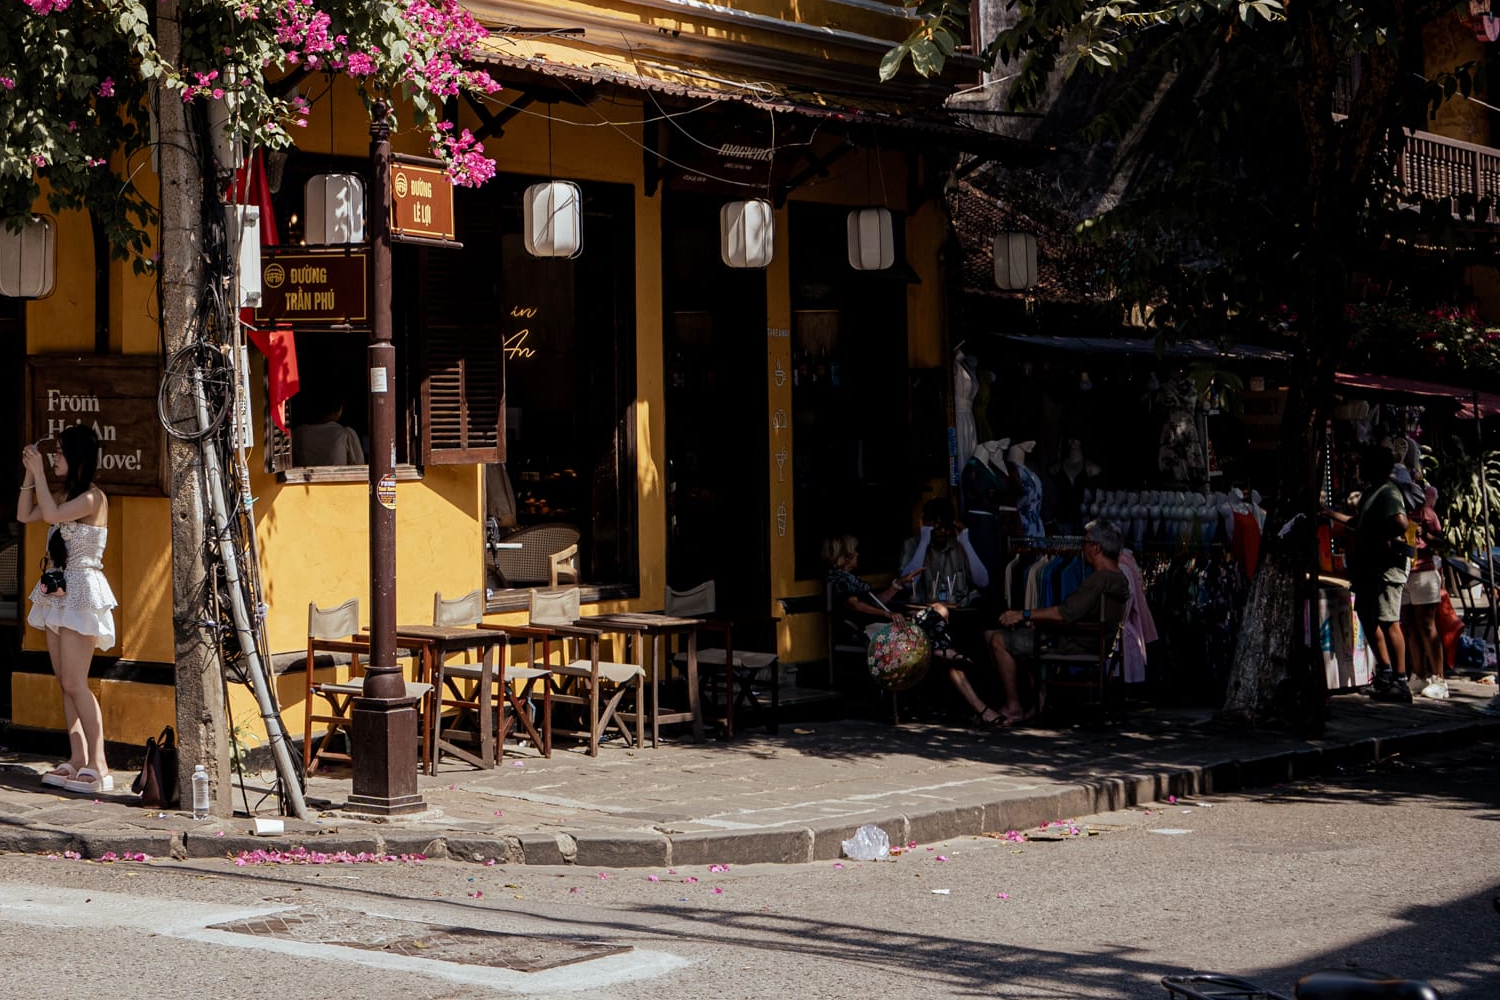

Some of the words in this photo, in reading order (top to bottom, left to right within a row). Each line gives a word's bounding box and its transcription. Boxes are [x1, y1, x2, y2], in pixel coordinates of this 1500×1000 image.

[413, 201, 421, 223] LÊ
[290, 264, 327, 284] ĐƯỜNG
[285, 286, 312, 310] TRẦN
[314, 288, 335, 310] PHÚ
[510, 305, 538, 318] in
[504, 328, 536, 360] An
[47, 389, 100, 412] From
[96, 447, 142, 470] love!
